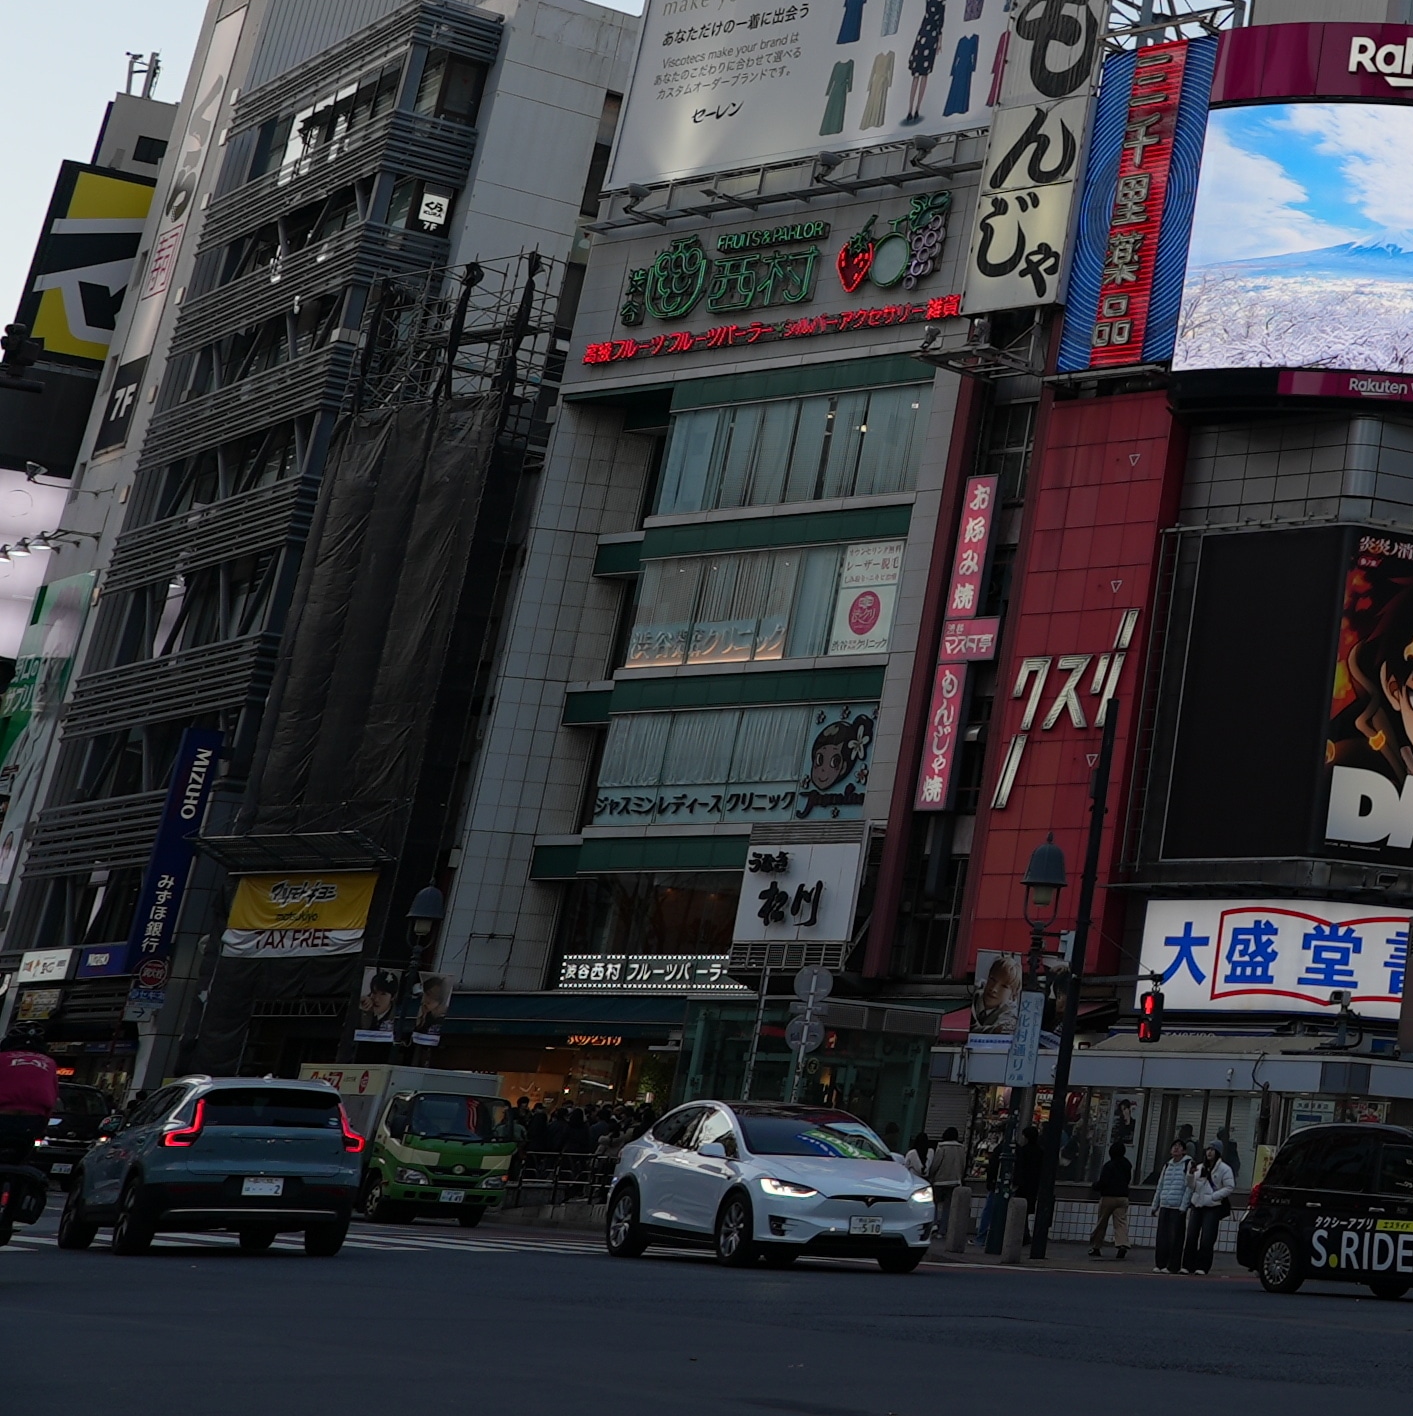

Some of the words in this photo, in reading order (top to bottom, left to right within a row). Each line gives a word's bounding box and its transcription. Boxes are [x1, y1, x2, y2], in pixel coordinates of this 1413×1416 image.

[662, 3, 810, 47] あなただけの一着に出会う
[692, 100, 744, 123] セーレン
[1092, 52, 1173, 348] 三千里薬品
[423, 221, 438, 231] 7F
[717, 221, 826, 251] FRUITS&PARLOR
[706, 245, 820, 313] 西村
[109, 382, 138, 422] 7F
[1349, 378, 1407, 398] Rakuten
[952, 483, 991, 612] お好み焼
[920, 670, 960, 802] もんじゃ焼
[180, 748, 213, 820] MIZUHO
[593, 788, 798, 816] ジャスミンレディースクリニック
[141, 874, 175, 954] みずほ銀行
[255, 929, 284, 949] TAX
[291, 929, 332, 948] FREE
[565, 963, 622, 981] 渋谷西村
[627, 963, 729, 982] フルーツパーラー
[1010, 999, 1035, 1071] 文化村通り
[1315, 1215, 1374, 1229] タクシーアプリ
